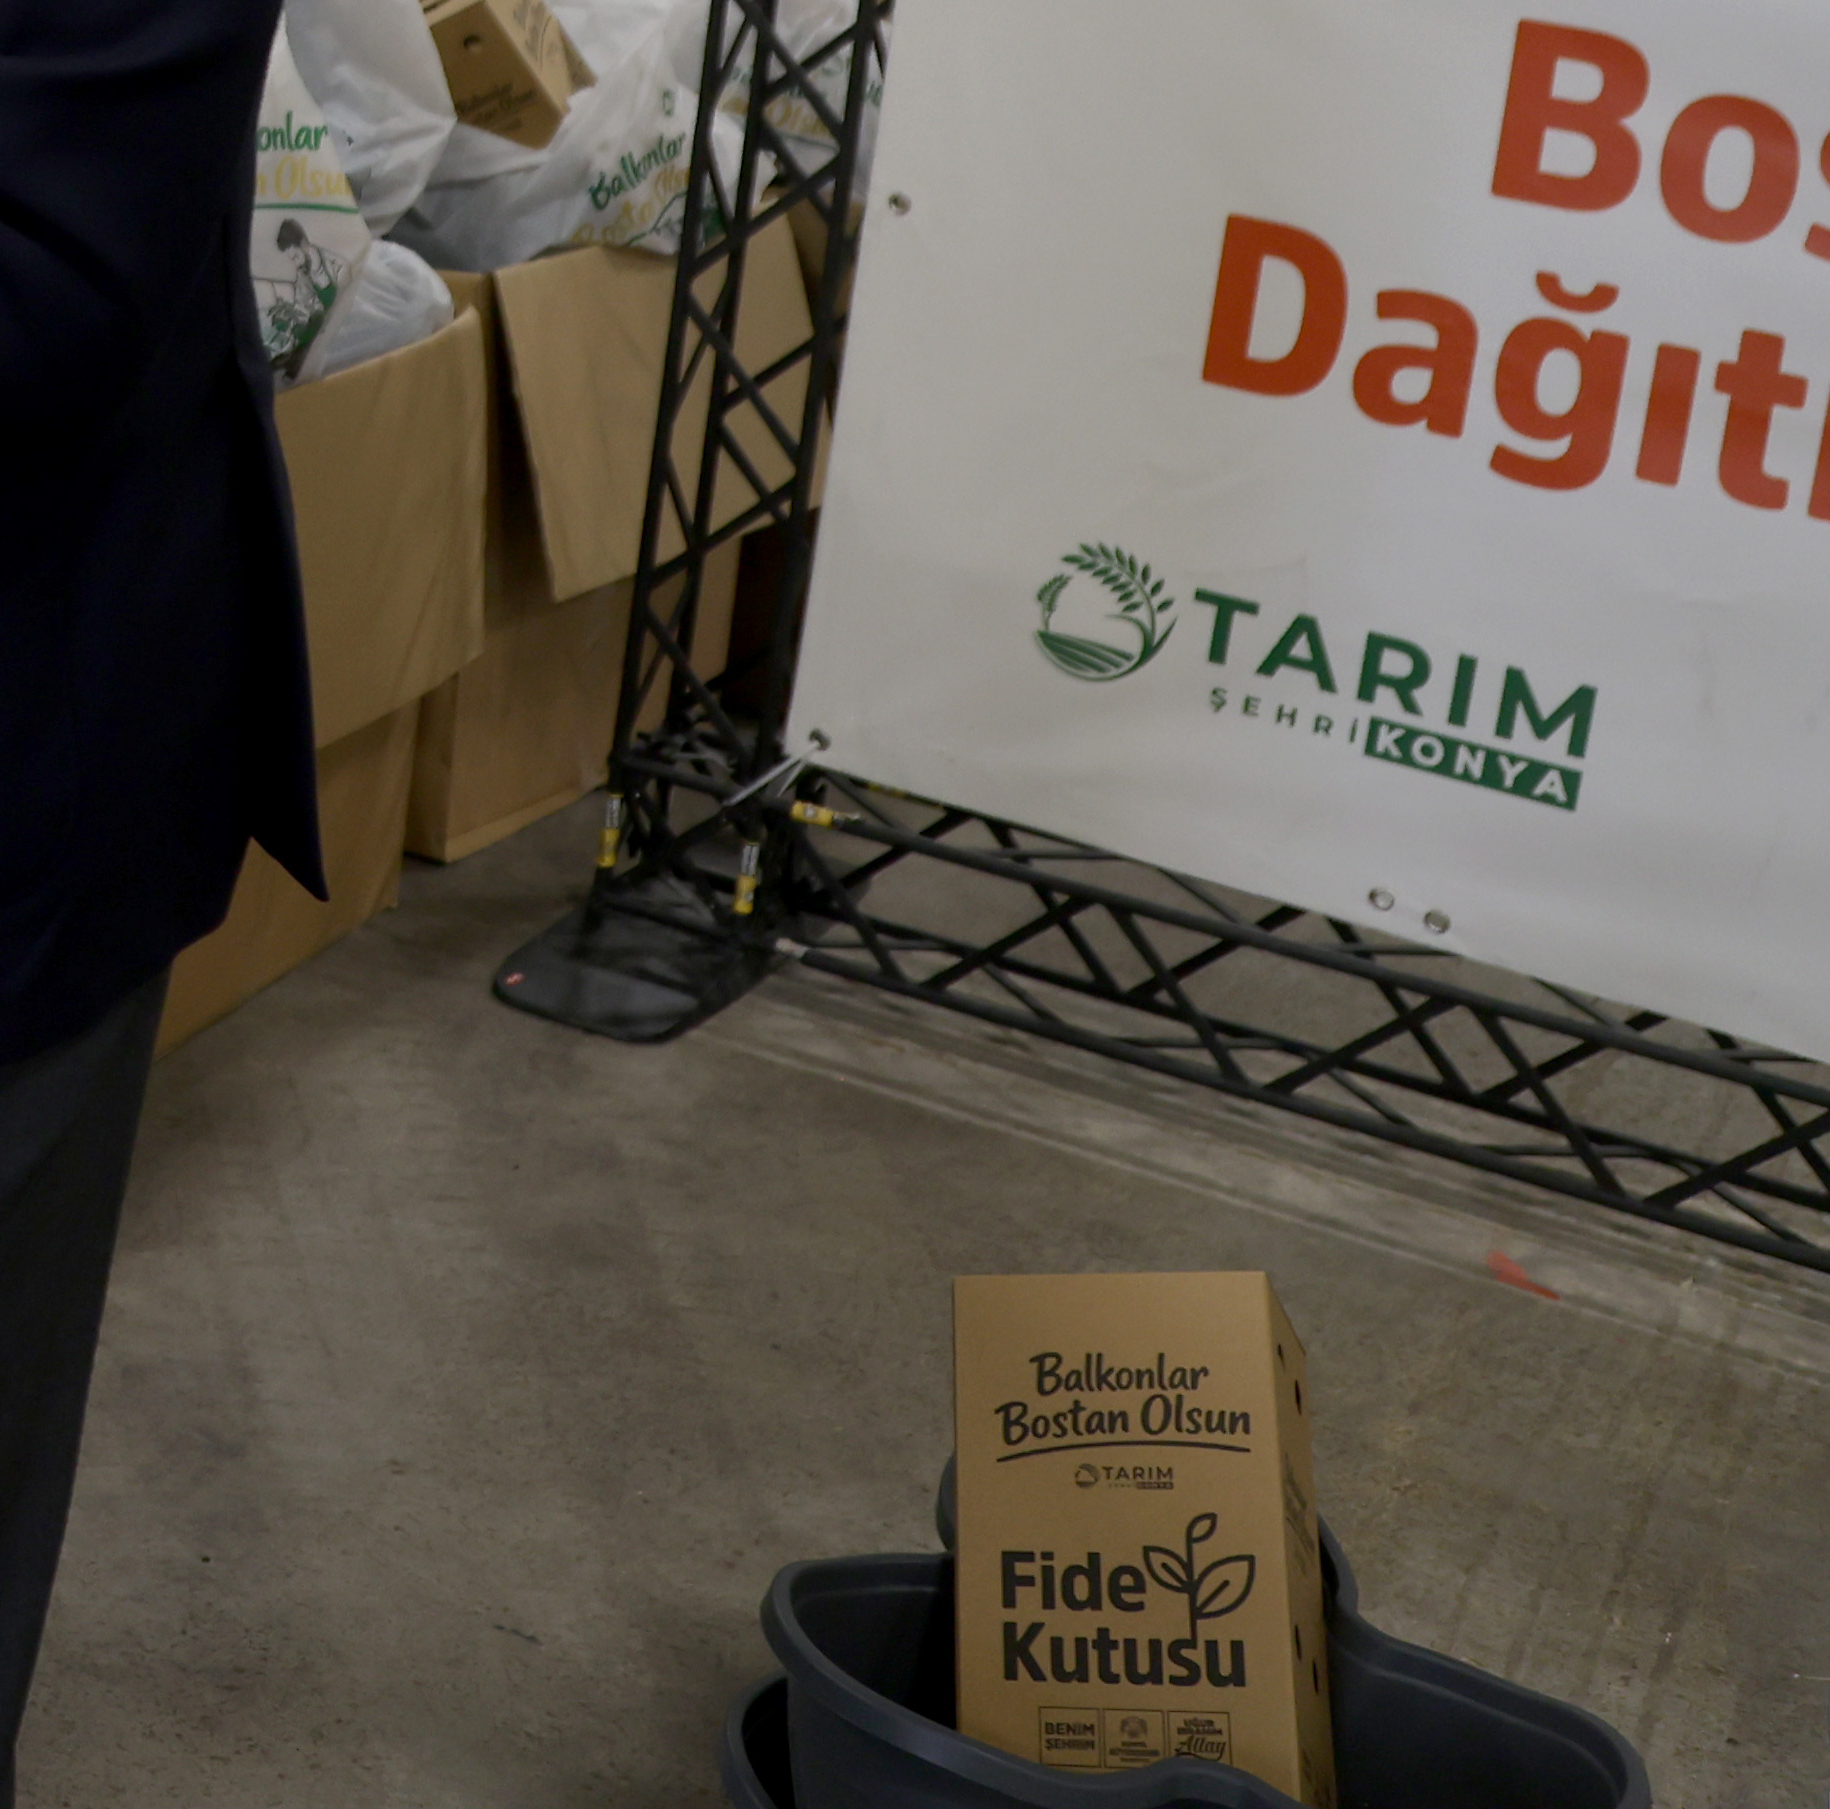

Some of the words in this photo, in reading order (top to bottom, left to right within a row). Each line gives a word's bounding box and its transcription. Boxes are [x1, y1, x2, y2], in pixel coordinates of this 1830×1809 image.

[1490, 18, 1830, 262] Bo
[1194, 587, 1598, 759] TARIM
[1210, 686, 1359, 745] ŞEHRİ
[1366, 718, 1582, 810] KONYA
[1029, 1352, 1209, 1396] Balkonlar
[994, 1401, 1130, 1446] Bostan
[1140, 1394, 1251, 1435] Olsun
[1101, 1466, 1174, 1481] TARIM
[1001, 1550, 1147, 1613] Fide
[1003, 1621, 1246, 1688] Kutusu
